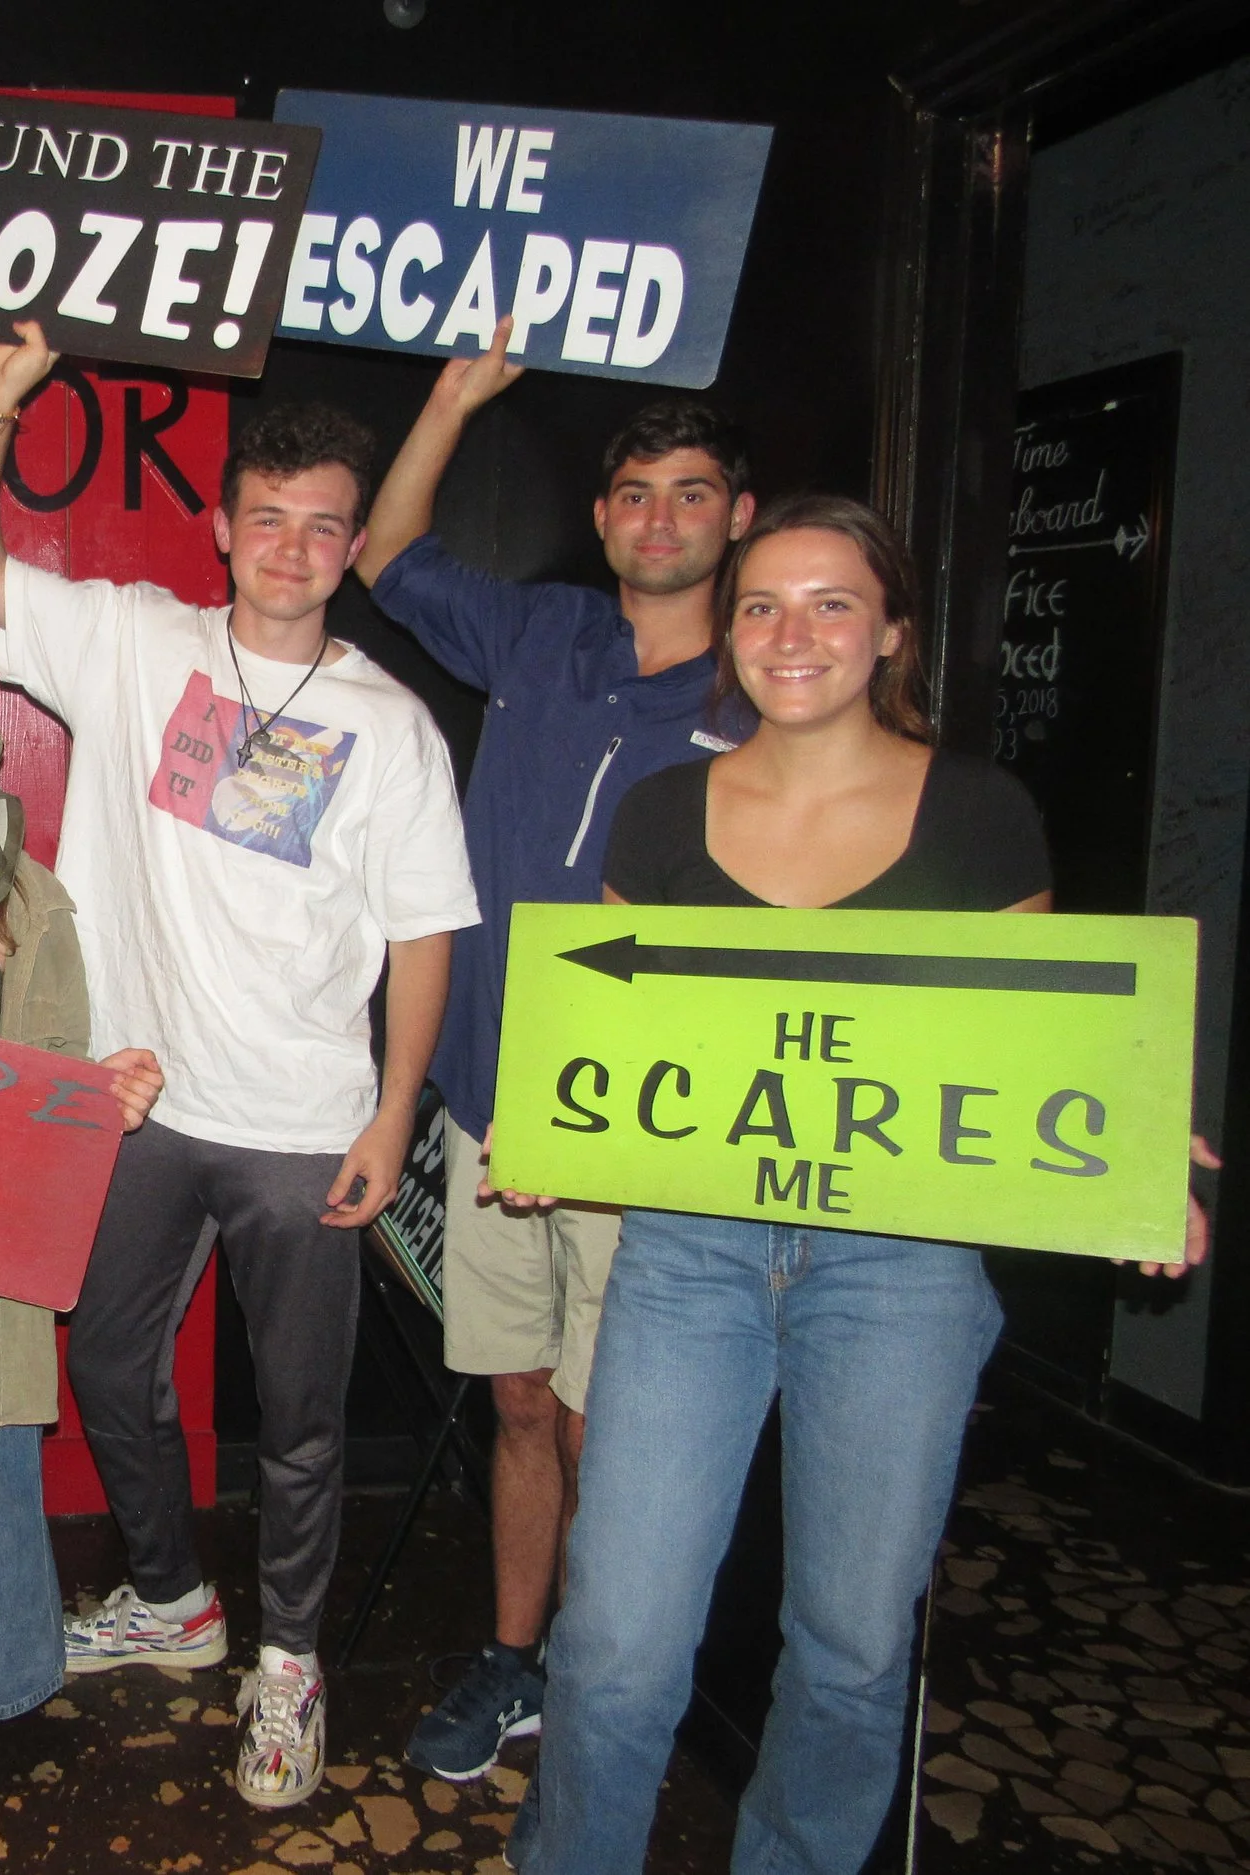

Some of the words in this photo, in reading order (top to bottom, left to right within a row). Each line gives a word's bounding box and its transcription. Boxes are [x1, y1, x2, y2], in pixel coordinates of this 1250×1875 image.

[152, 139, 288, 200] THE
[453, 123, 555, 214] WE
[280, 213, 684, 369] ESCAPED
[1012, 421, 1071, 473] Time
[170, 731, 214, 765] DID
[168, 771, 196, 797] IT
[774, 1011, 856, 1063] HE
[550, 1056, 1109, 1177] SCARES
[754, 1156, 853, 1214] ME
